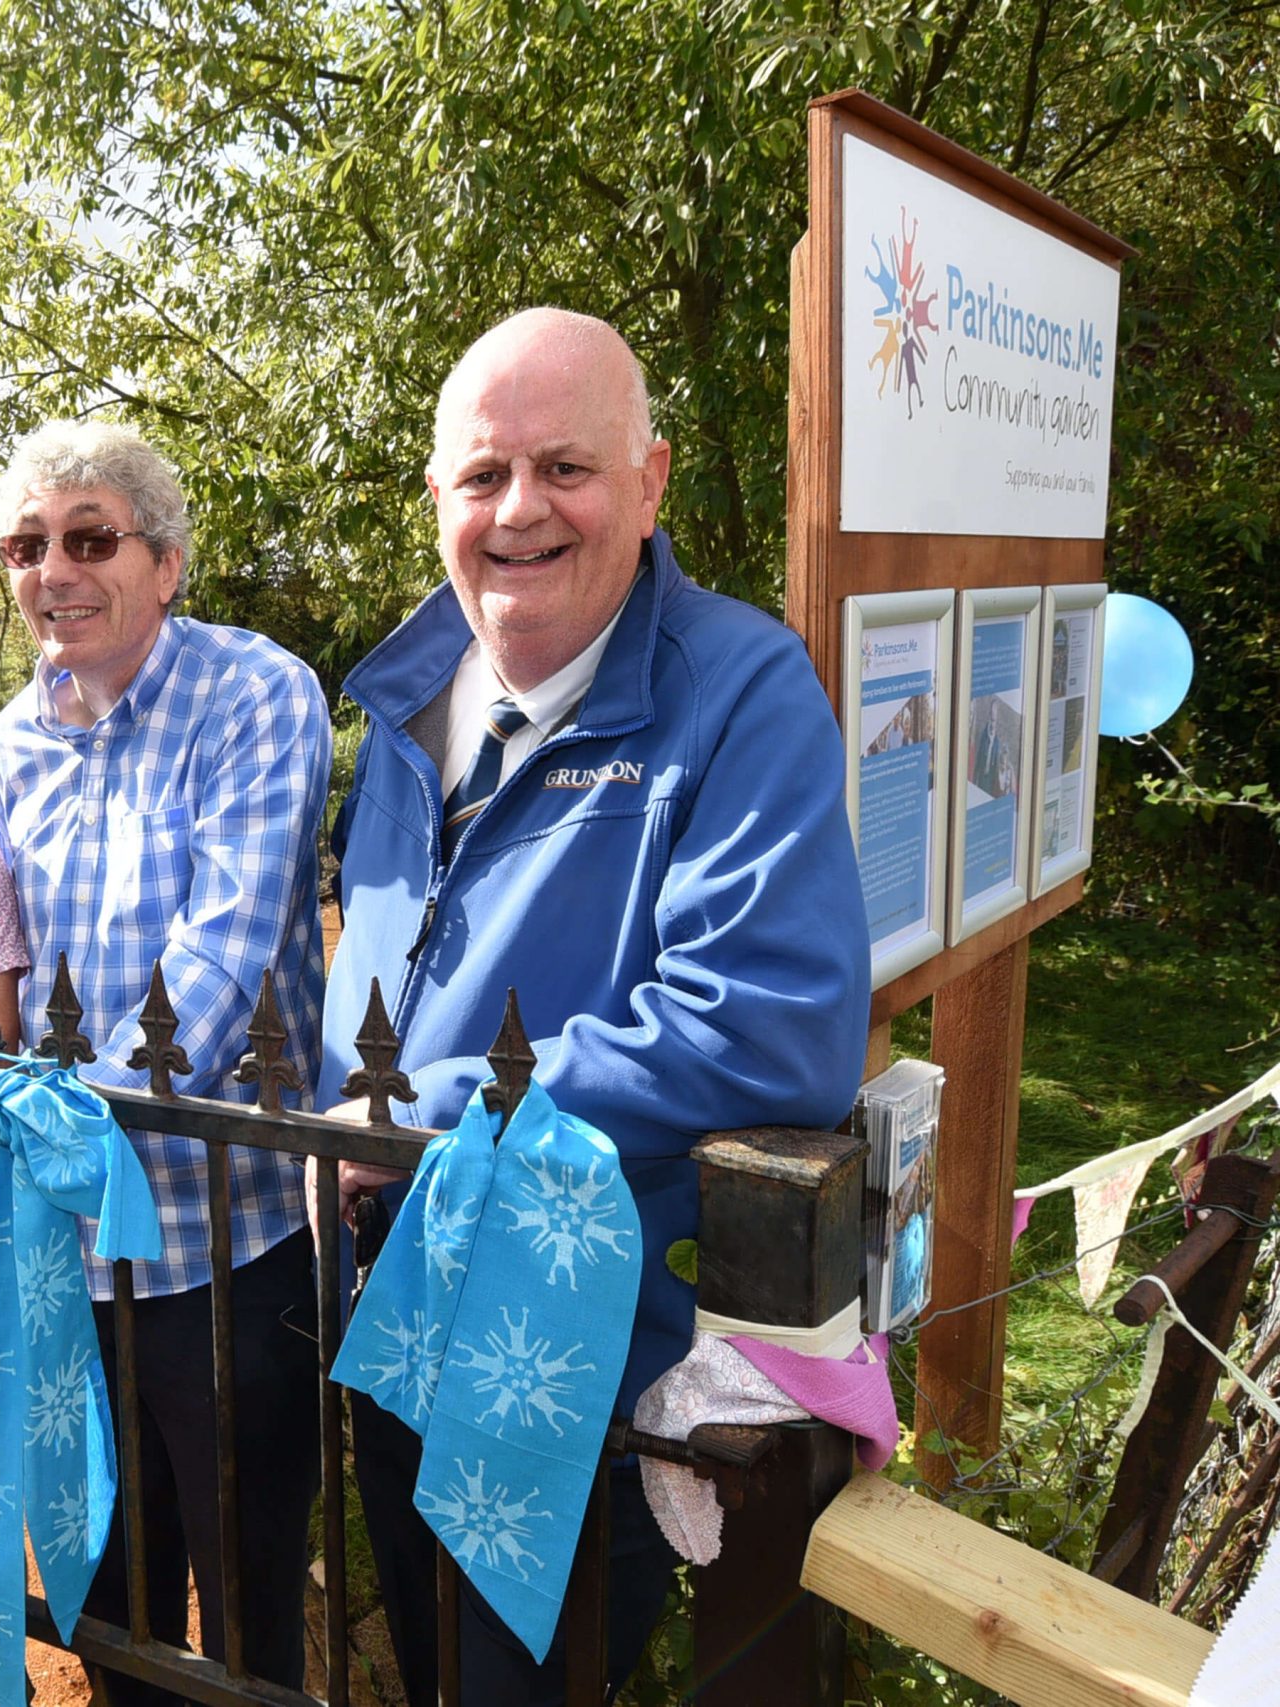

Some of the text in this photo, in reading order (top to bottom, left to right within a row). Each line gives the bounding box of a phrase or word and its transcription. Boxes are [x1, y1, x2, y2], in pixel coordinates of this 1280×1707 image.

[946, 263, 1103, 380] Parkinsons.Me
[944, 344, 1100, 447] Community garden
